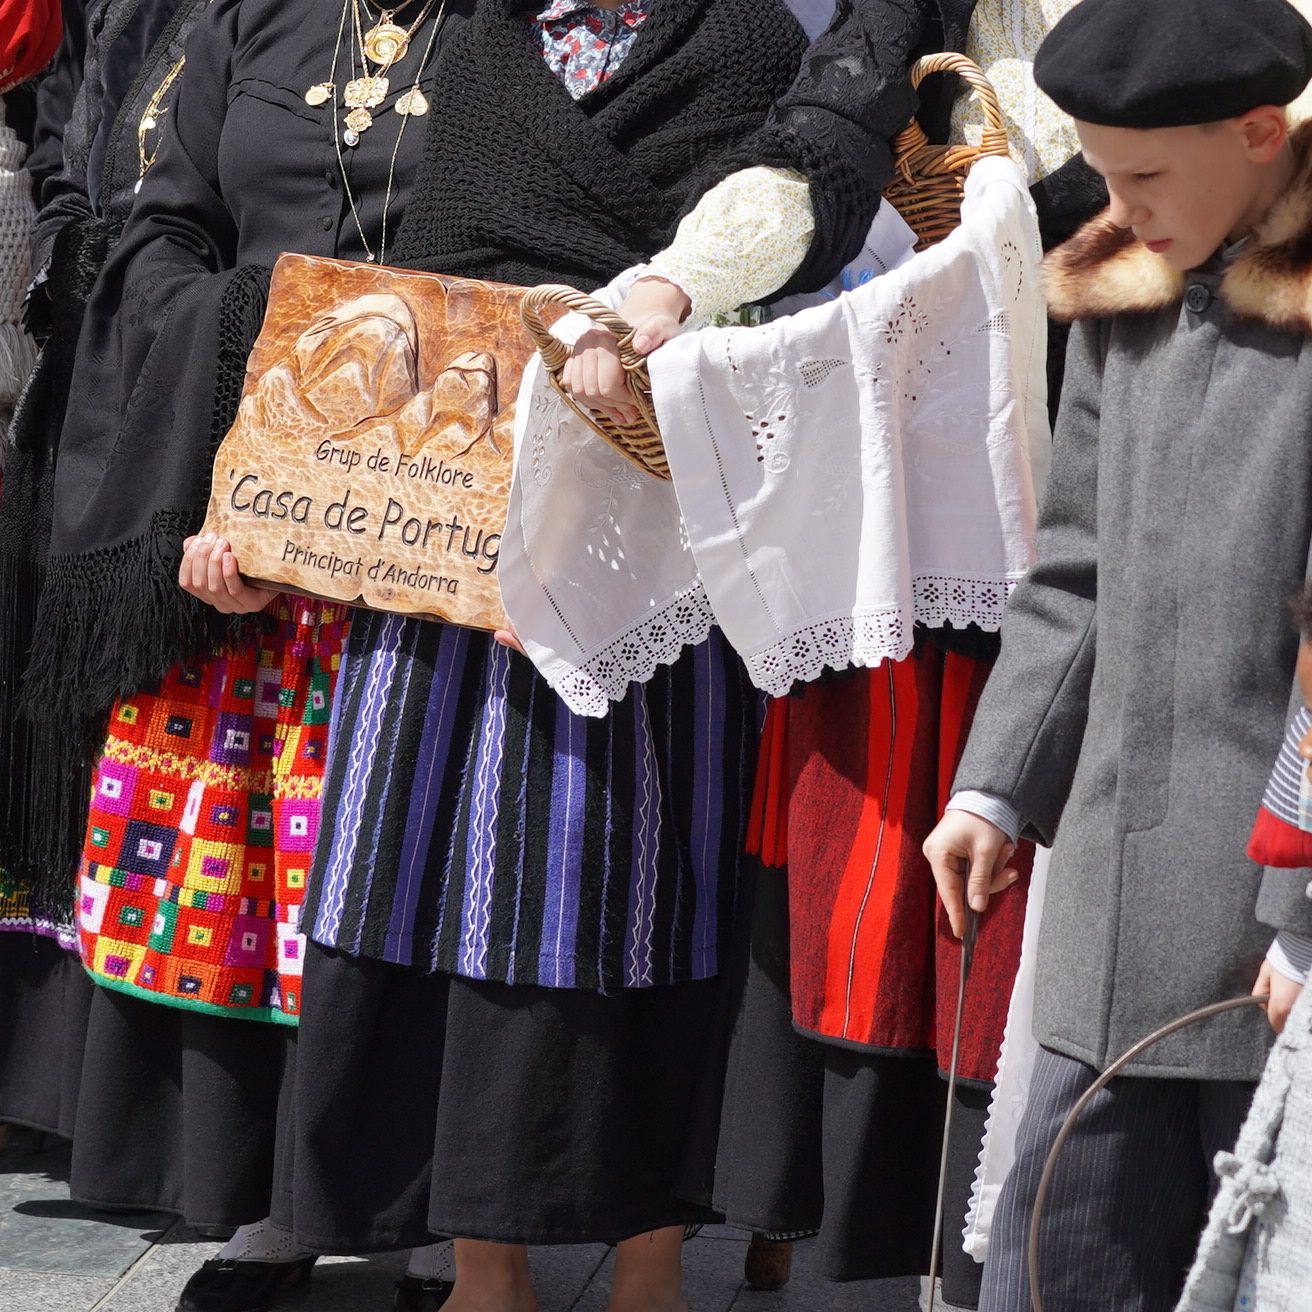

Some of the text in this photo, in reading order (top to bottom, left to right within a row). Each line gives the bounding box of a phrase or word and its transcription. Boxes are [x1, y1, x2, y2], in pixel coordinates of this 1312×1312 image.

[315, 439, 475, 489] Grup de Folklore
[324, 489, 369, 535] de
[378, 497, 502, 576] Portug
[282, 540, 459, 594] Principat d'Andorra
